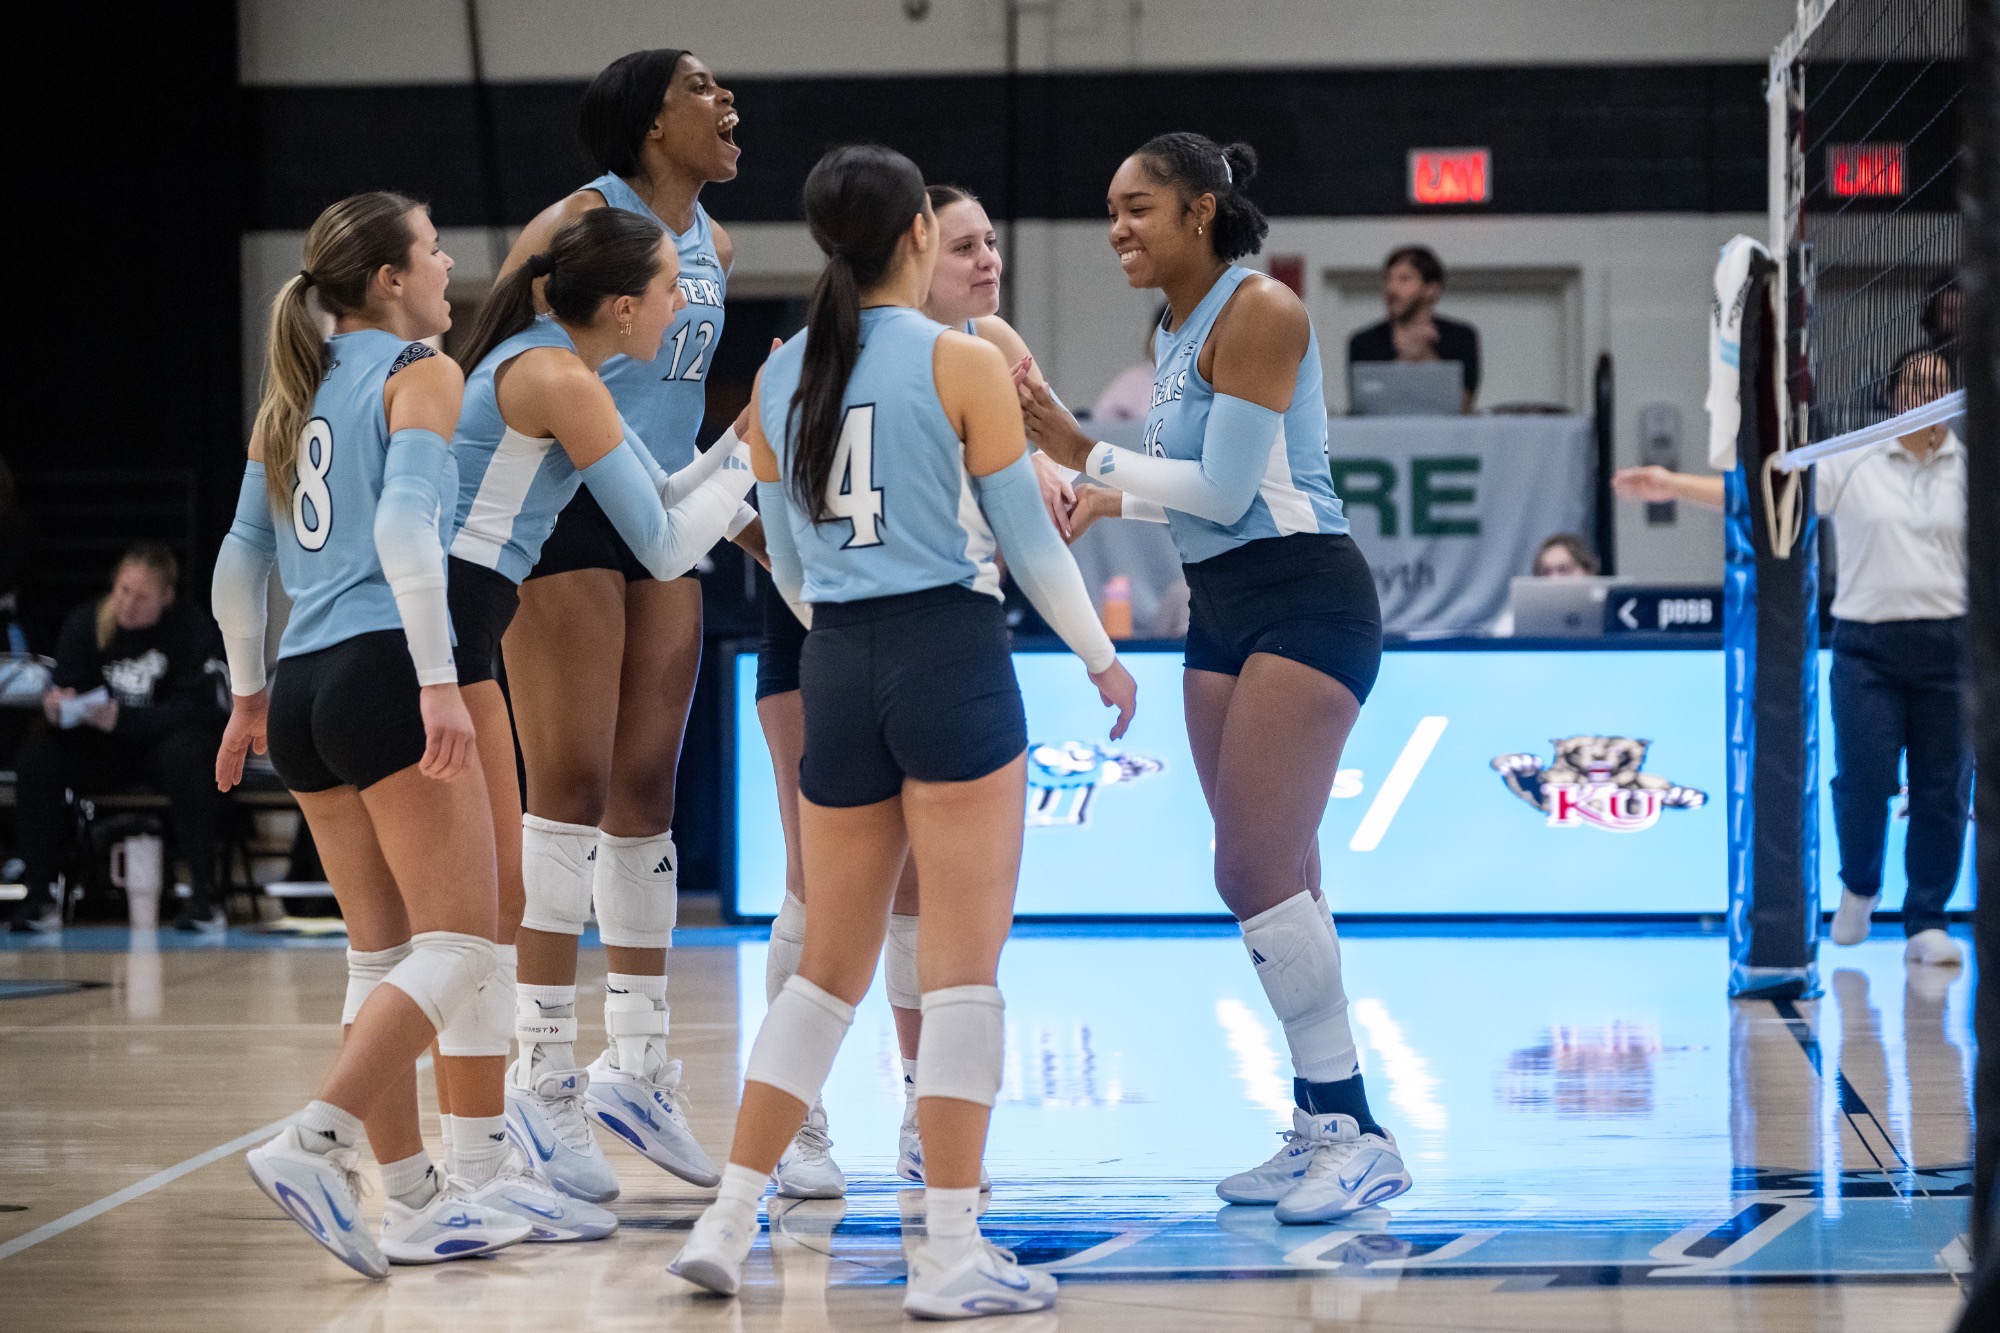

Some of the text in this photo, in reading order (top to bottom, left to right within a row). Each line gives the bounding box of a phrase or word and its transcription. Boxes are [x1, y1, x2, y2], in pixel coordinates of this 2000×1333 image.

[662, 320, 715, 382] 12
[293, 416, 333, 552] 8
[816, 402, 887, 550] 4
[1541, 782, 1667, 833] KU
